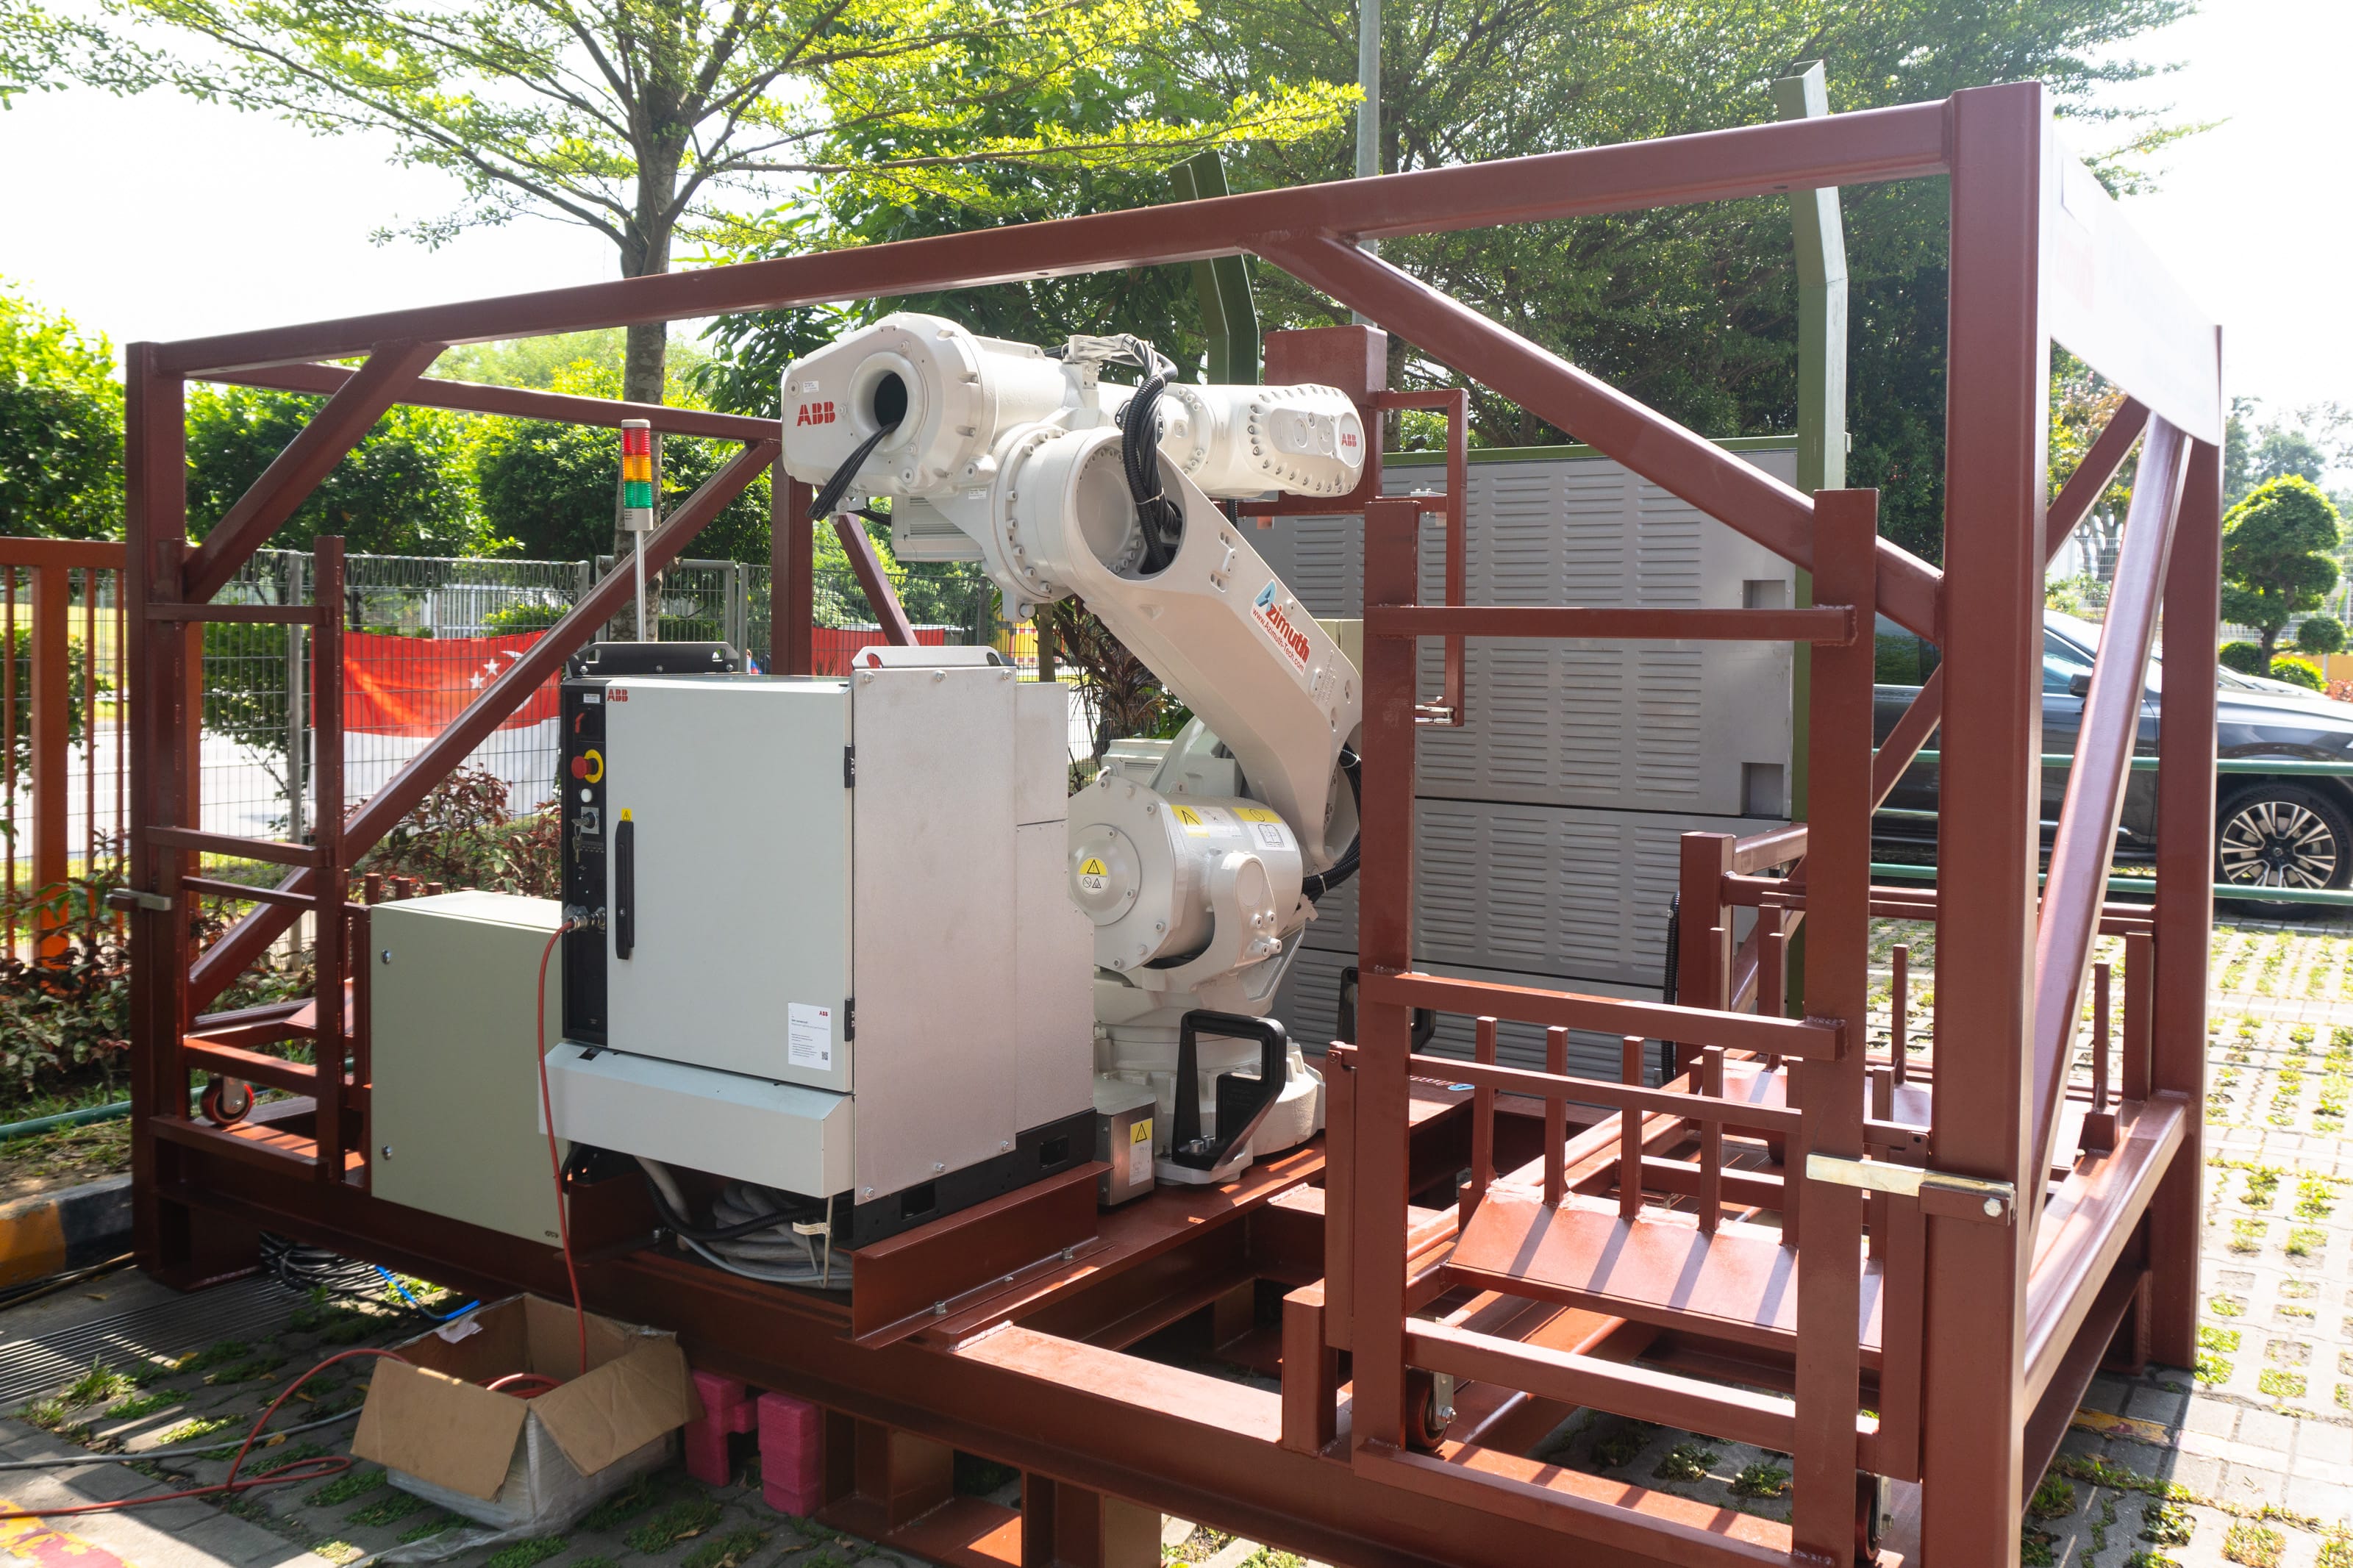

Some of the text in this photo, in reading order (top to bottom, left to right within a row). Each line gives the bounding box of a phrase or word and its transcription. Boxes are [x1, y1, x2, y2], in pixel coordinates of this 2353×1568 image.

[797, 401, 835, 426] ABB
[1341, 434, 1357, 447] ABB
[1254, 581, 1310, 663] Azimuth
[1252, 608, 1304, 672] www.Azimuth-Tech.com
[607, 689, 628, 702] ABB
